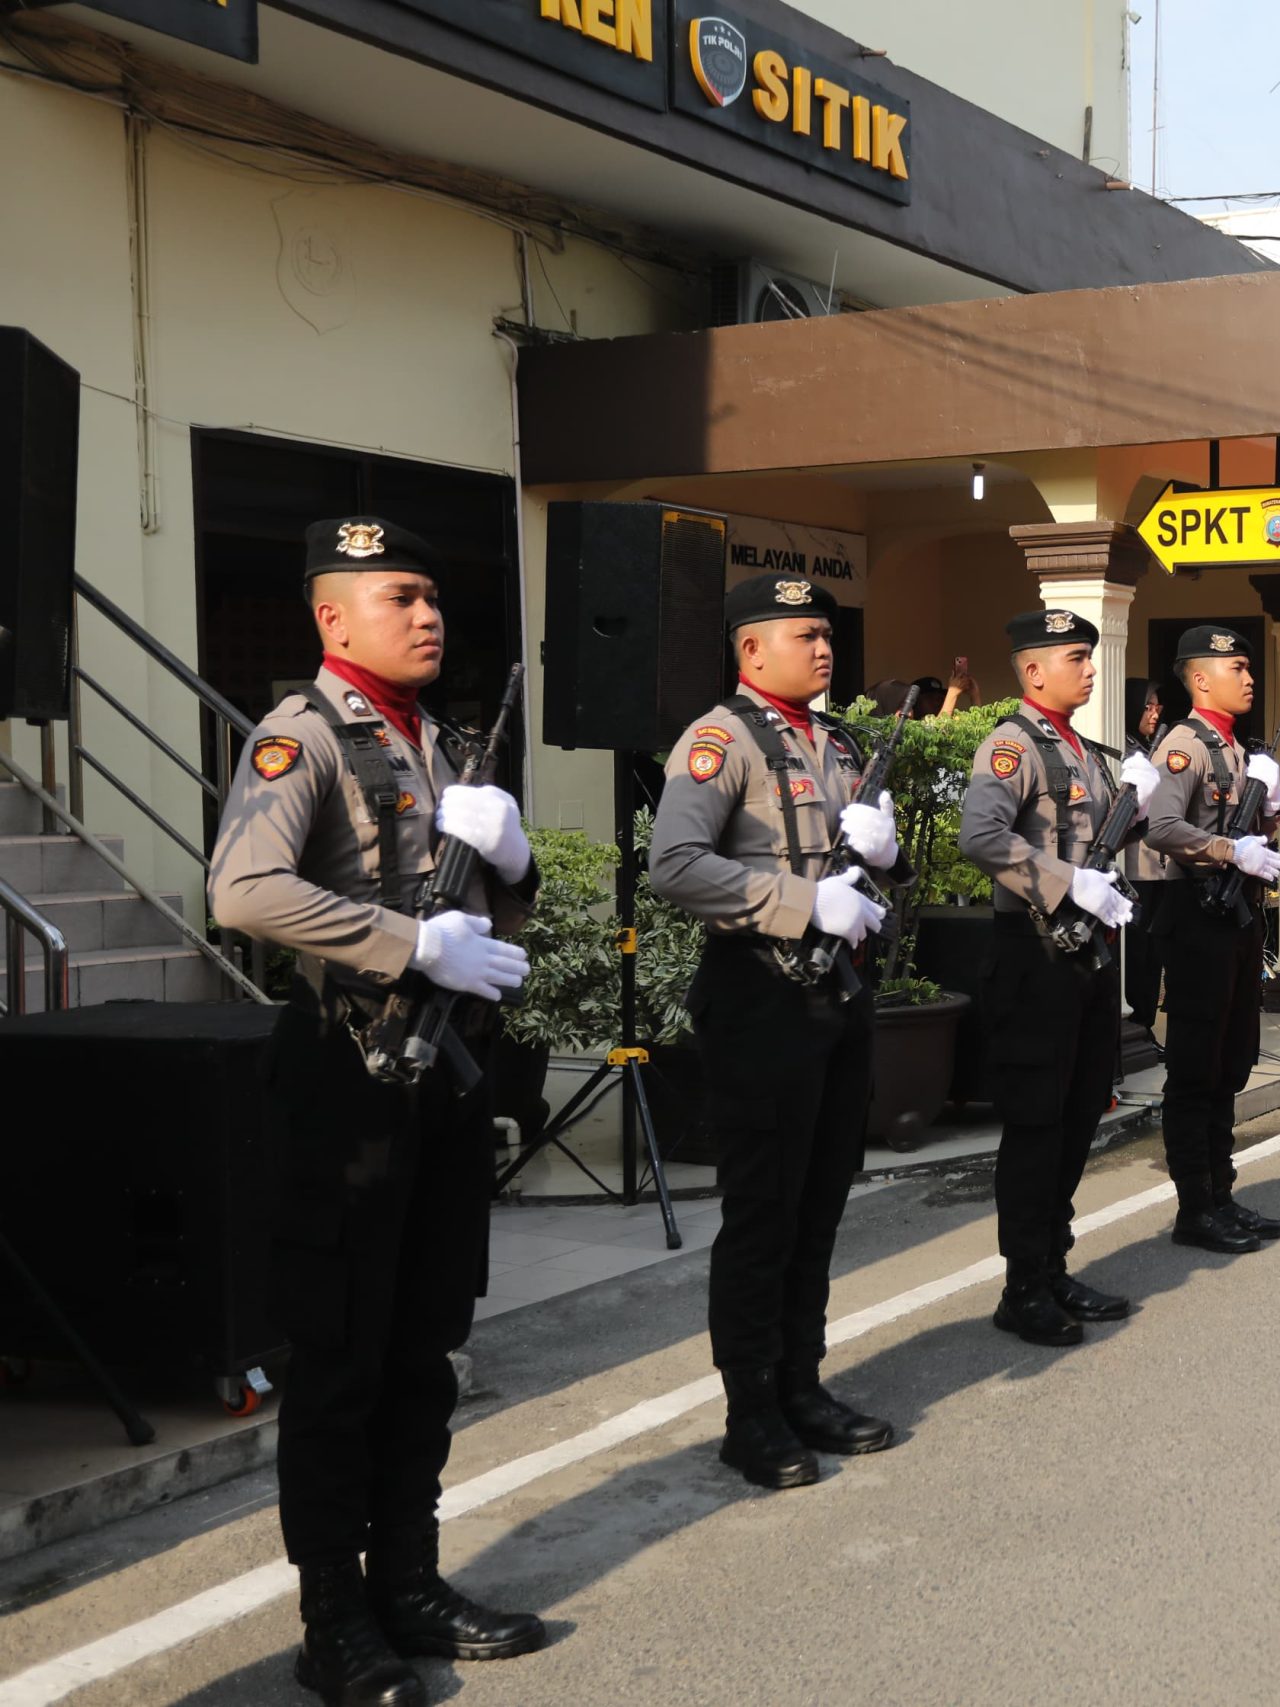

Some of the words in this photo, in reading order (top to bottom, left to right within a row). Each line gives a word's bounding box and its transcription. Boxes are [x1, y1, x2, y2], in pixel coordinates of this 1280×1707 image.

[702, 35, 717, 46] TIK
[718, 36, 743, 61] POLRI
[752, 50, 909, 180] SITIK
[1157, 506, 1251, 547] SPKT
[731, 543, 806, 575] MELAYANI
[812, 555, 853, 580] ANDA
